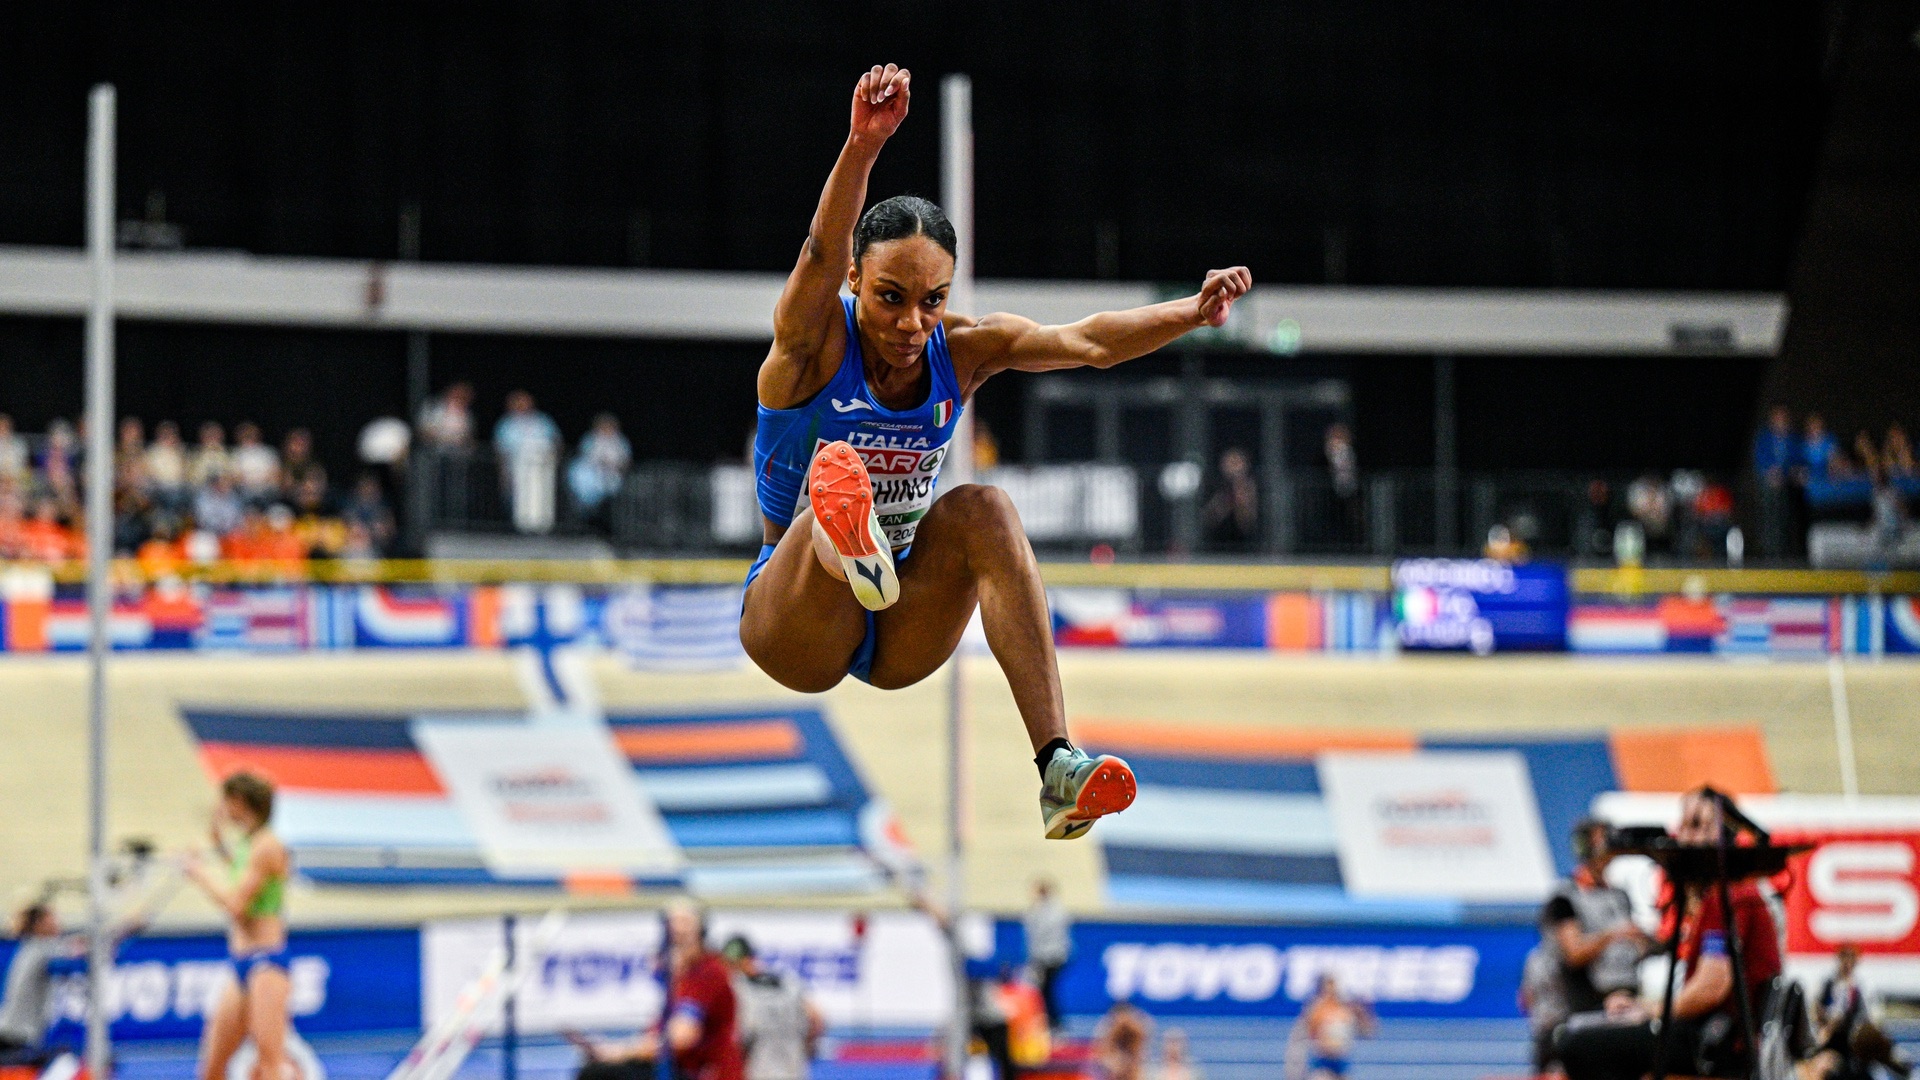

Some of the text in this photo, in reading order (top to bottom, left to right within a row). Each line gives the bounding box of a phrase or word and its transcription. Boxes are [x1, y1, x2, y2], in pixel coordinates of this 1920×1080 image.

[846, 431, 930, 449] ITALIA
[859, 452, 916, 471] PAR
[871, 475, 933, 504] HINO
[879, 514, 903, 525] EAN
[893, 526, 916, 540] 202
[1104, 943, 1282, 1001] TOYO
